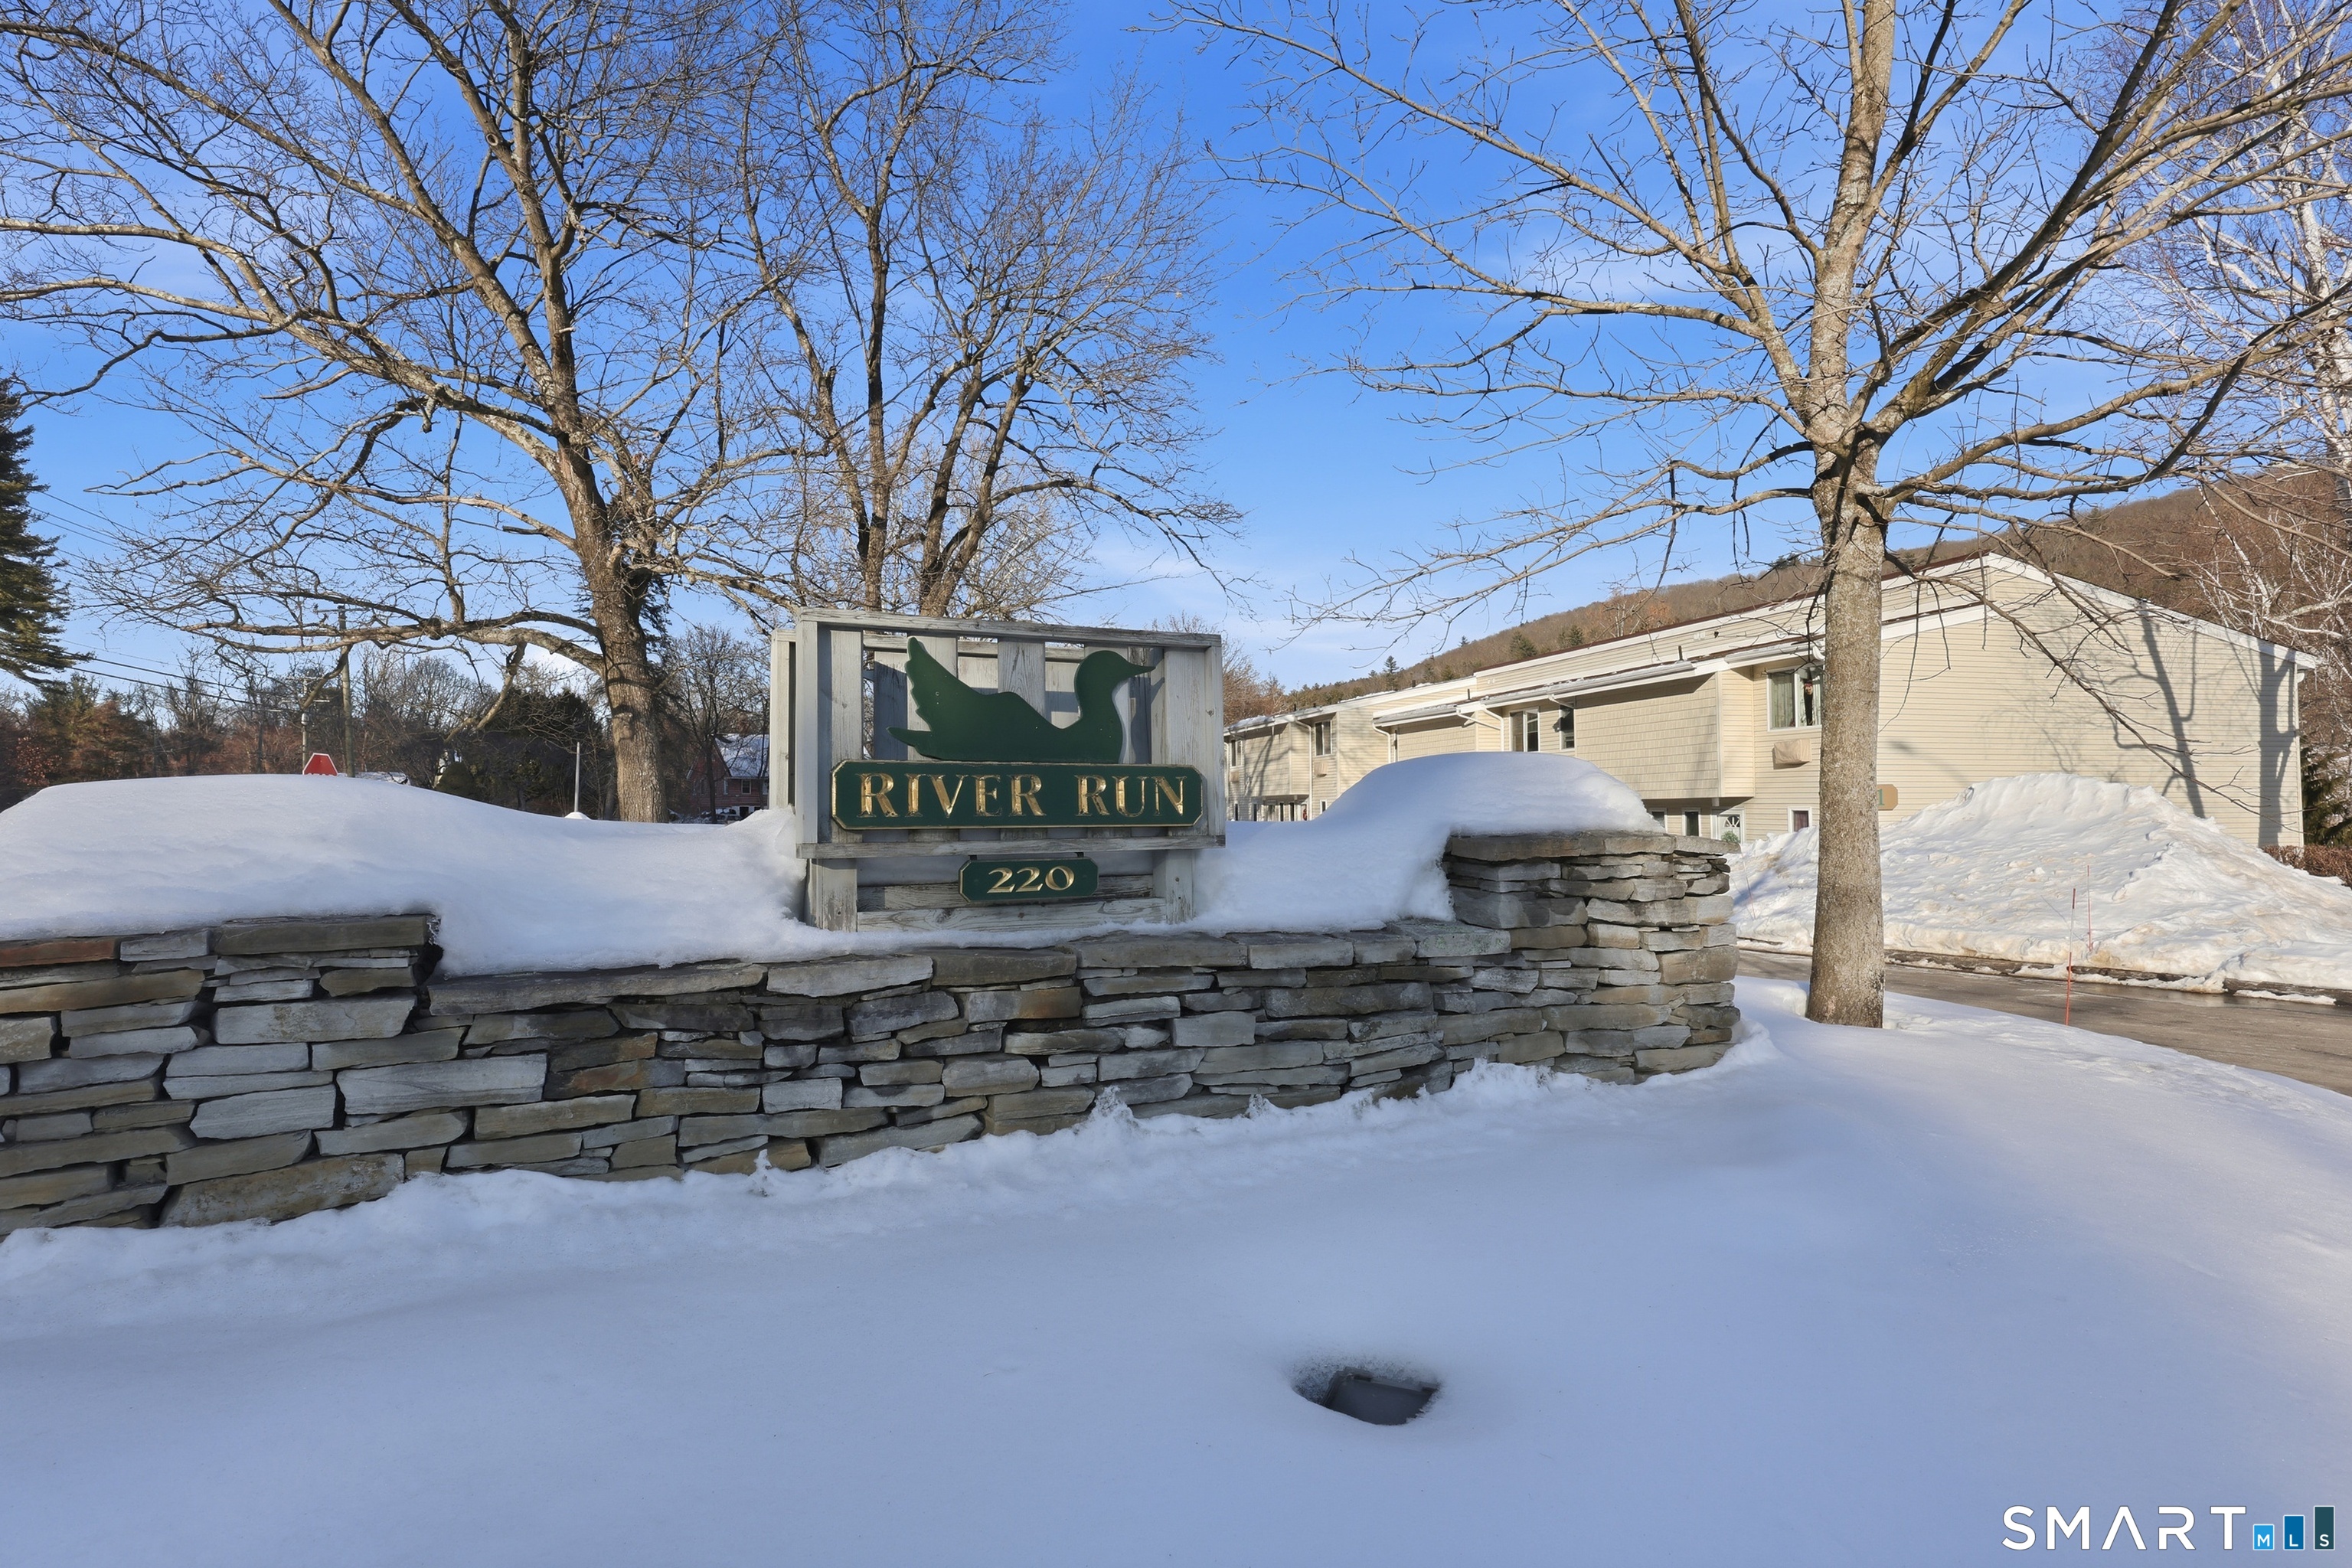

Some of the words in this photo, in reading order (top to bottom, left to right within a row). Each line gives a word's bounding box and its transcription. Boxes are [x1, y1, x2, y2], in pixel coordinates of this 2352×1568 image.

[855, 773, 1046, 818] RIVER
[1073, 774, 1187, 817] RUN
[987, 866, 1075, 893] 220
